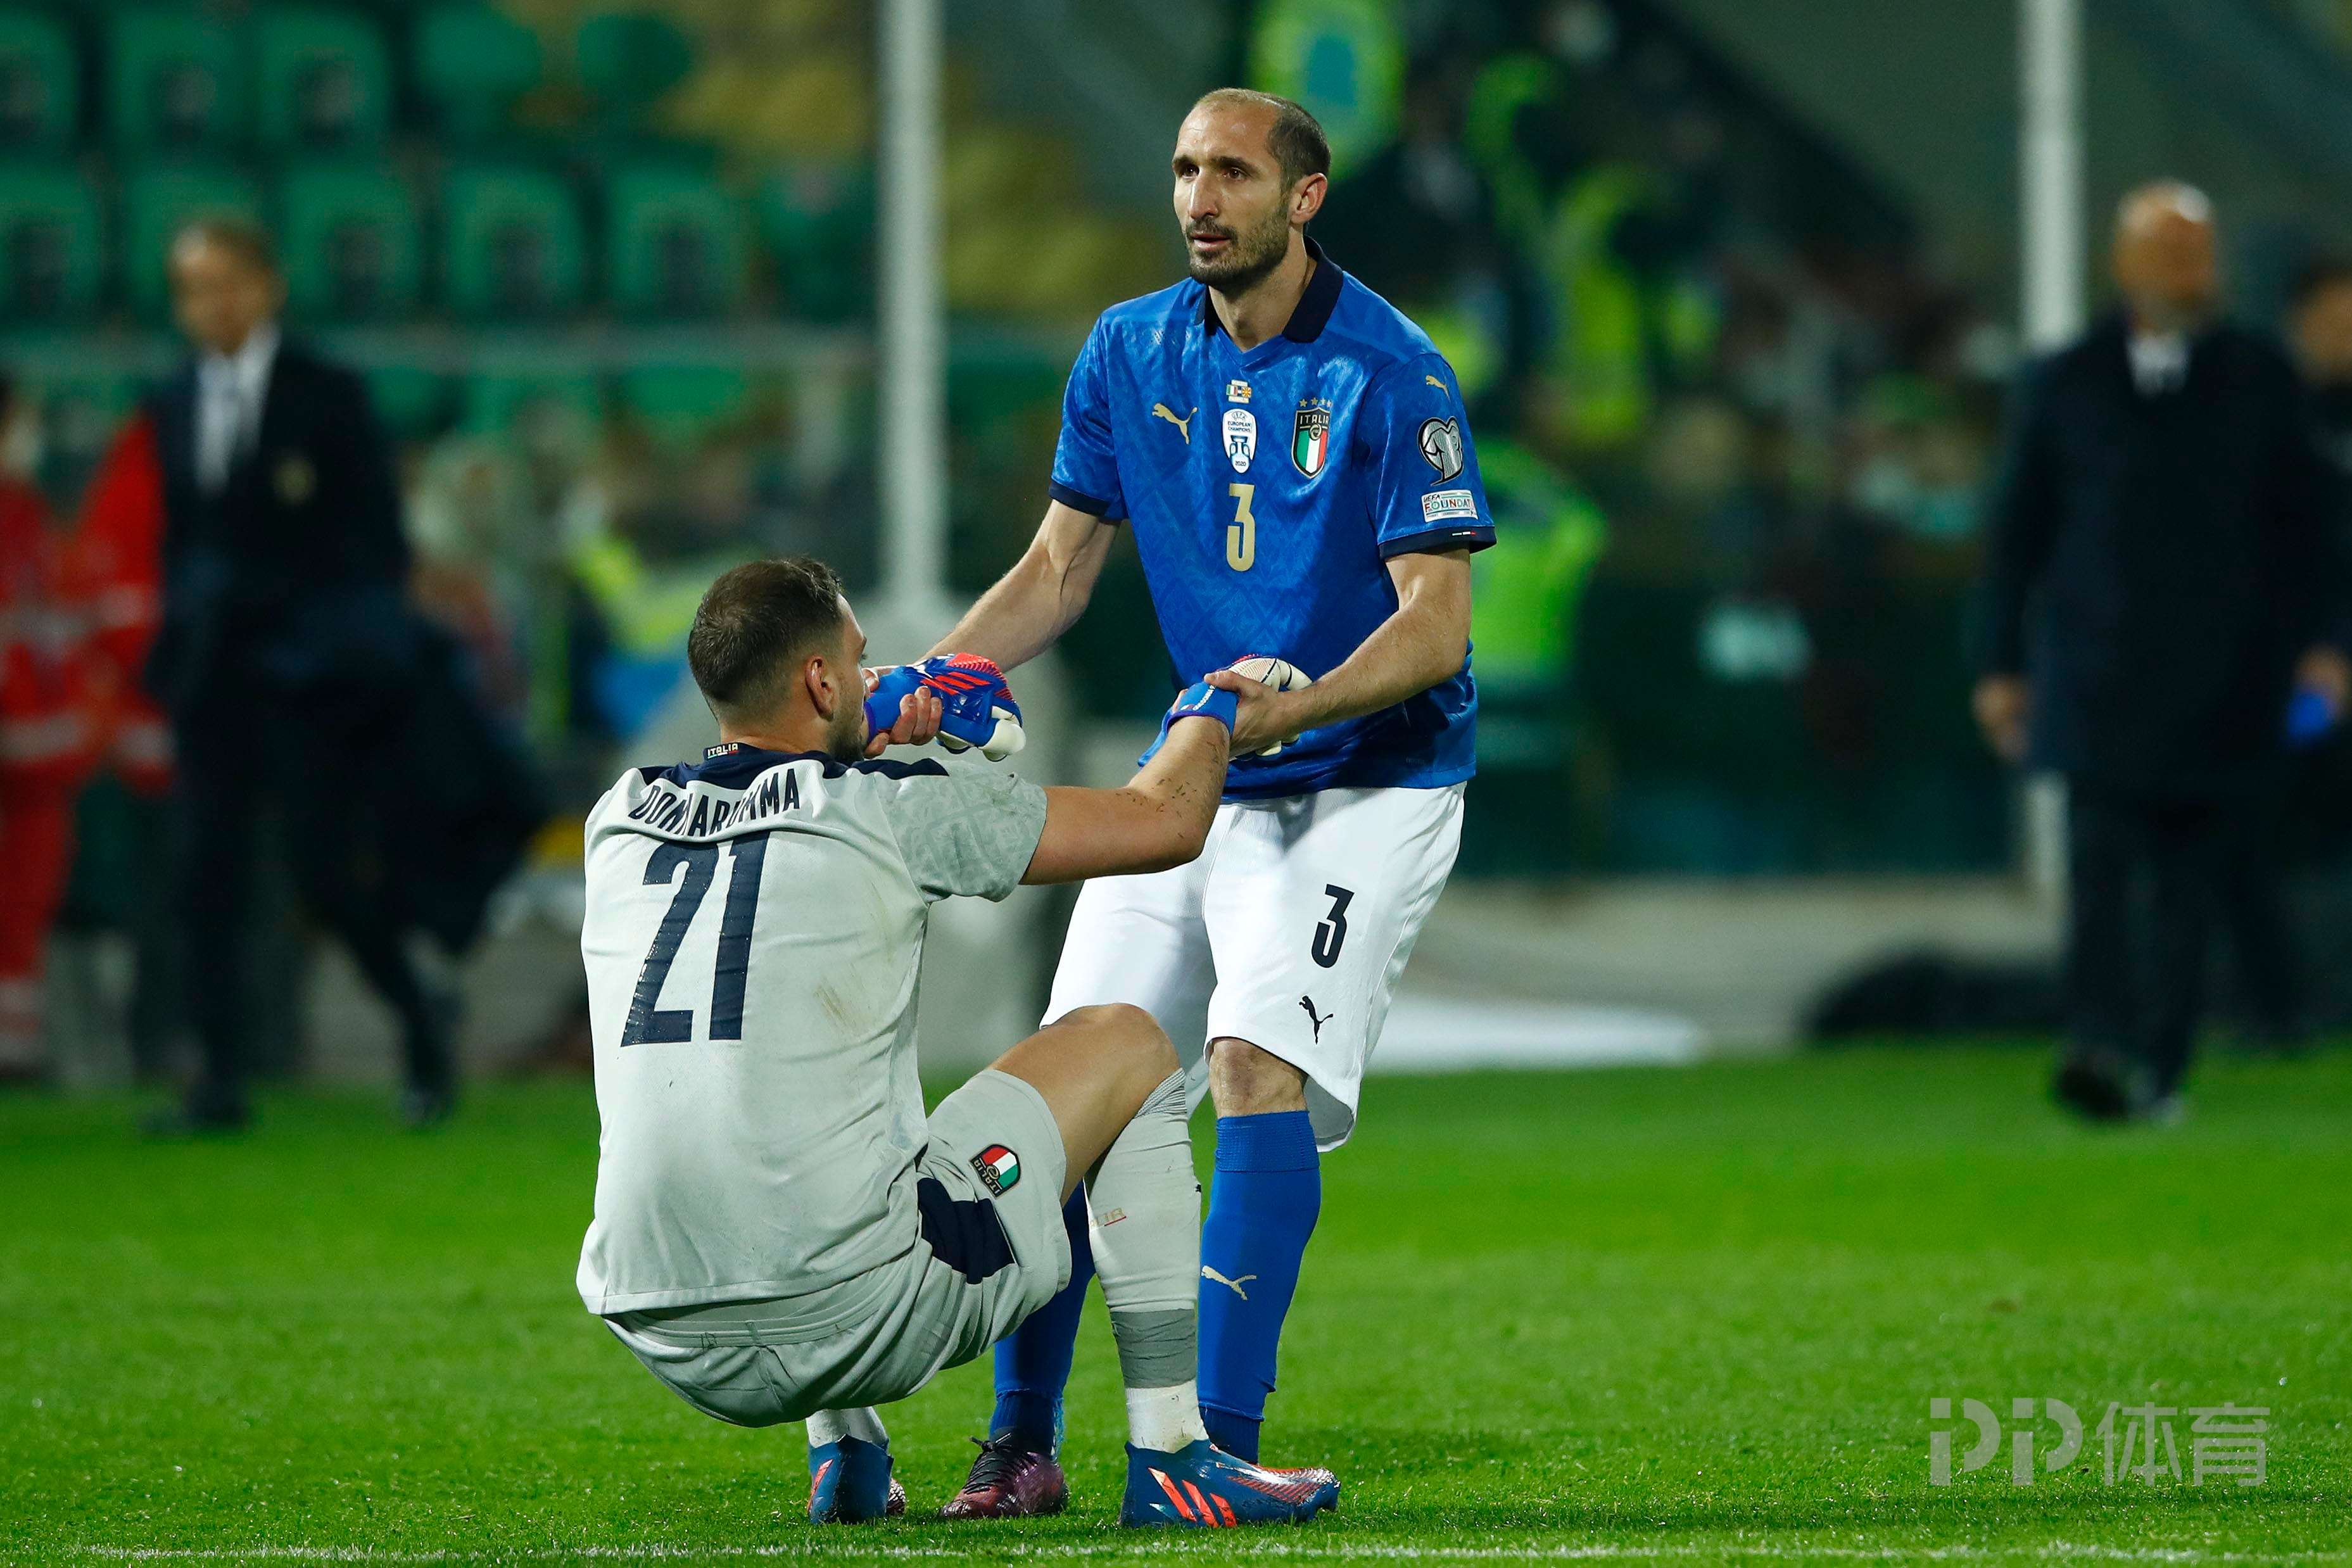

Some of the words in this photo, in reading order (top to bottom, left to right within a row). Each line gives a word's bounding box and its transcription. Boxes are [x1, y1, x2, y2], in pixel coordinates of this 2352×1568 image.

[1232, 411, 1248, 420] UEFA
[1300, 414, 1329, 424] ITALIA
[1424, 494, 1440, 502] UEFA
[1227, 483, 1255, 572] 3
[707, 743, 738, 757] ITALIA
[1311, 883, 1355, 968] 3
[620, 830, 770, 1046] 21
[973, 1160, 1001, 1194] ITALIA
